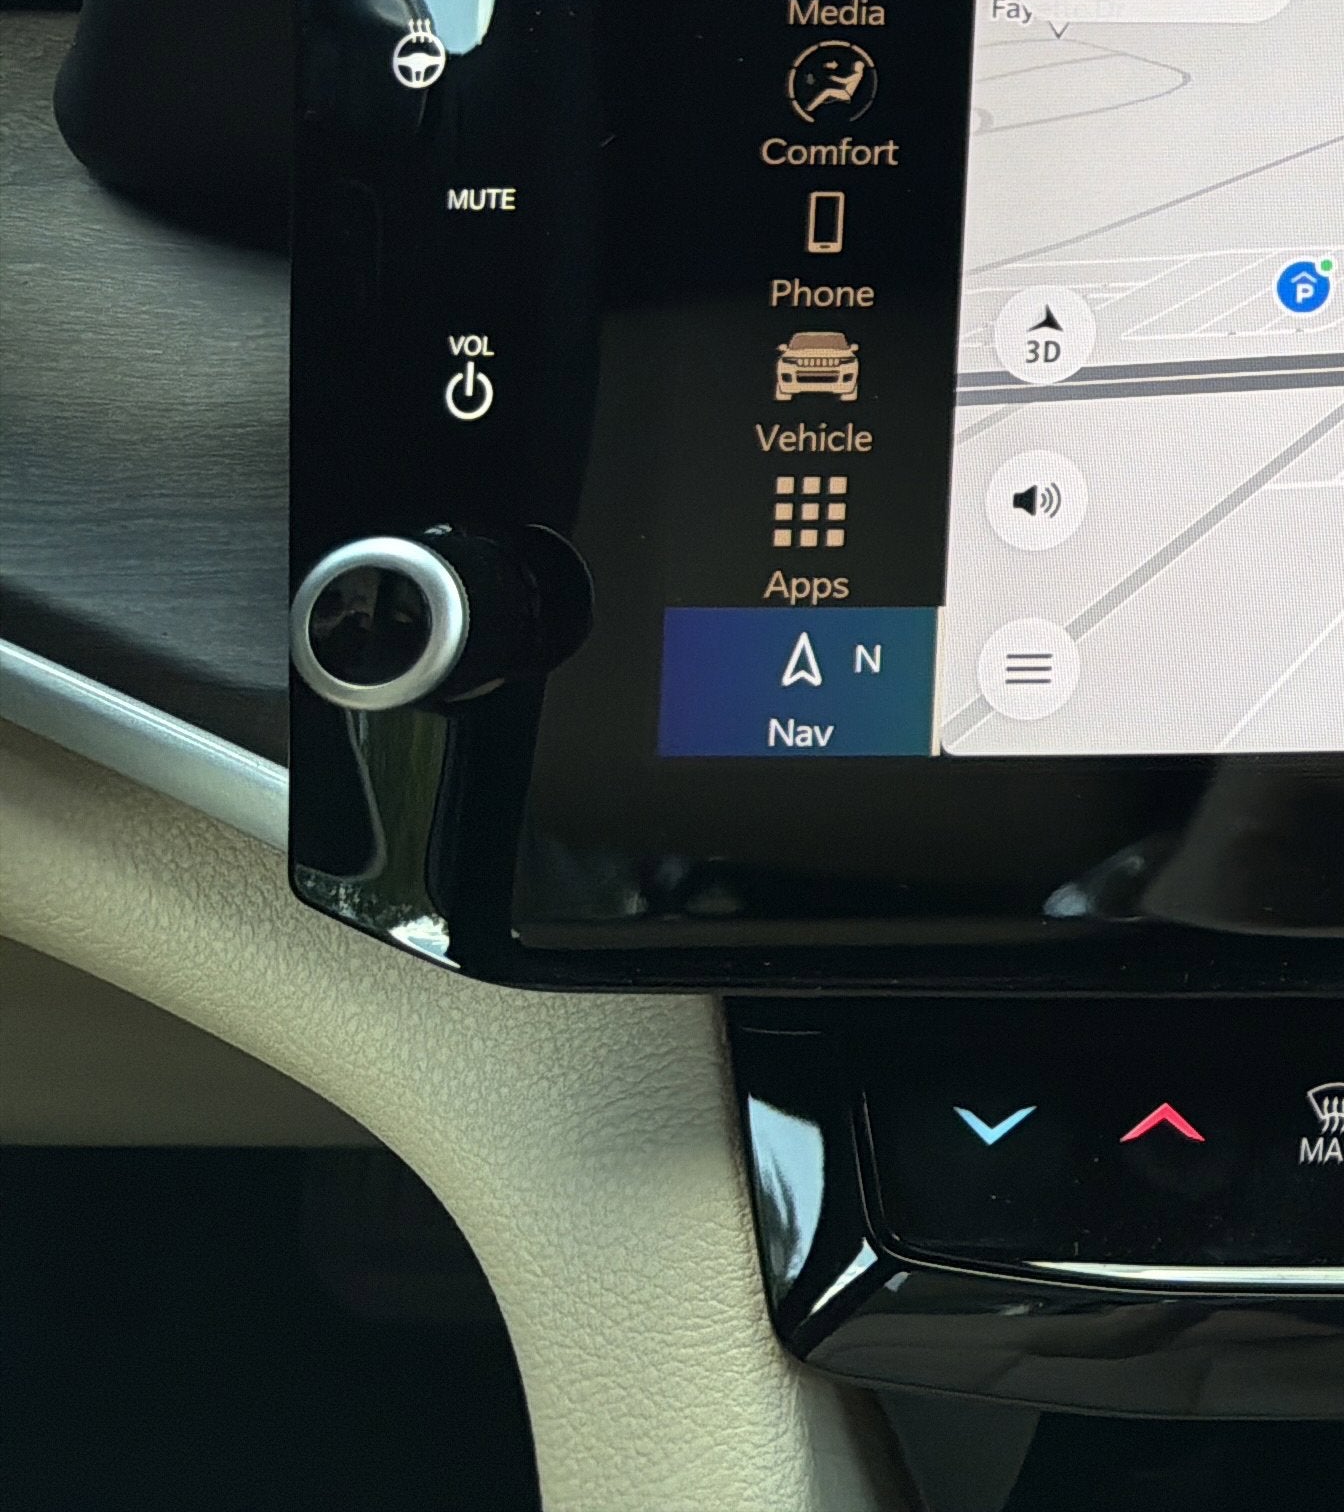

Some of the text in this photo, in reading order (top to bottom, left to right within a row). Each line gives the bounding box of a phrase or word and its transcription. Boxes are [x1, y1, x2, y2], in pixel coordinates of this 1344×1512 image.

[761, 137, 899, 167] Comfort
[448, 189, 516, 211] MUTE
[770, 279, 875, 308] Phone
[449, 335, 494, 356] VOL
[1026, 339, 1061, 364] 3D
[756, 423, 873, 452] Vehicle
[764, 570, 850, 604] Apps
[855, 646, 881, 672] N
[768, 719, 834, 747] Nav
